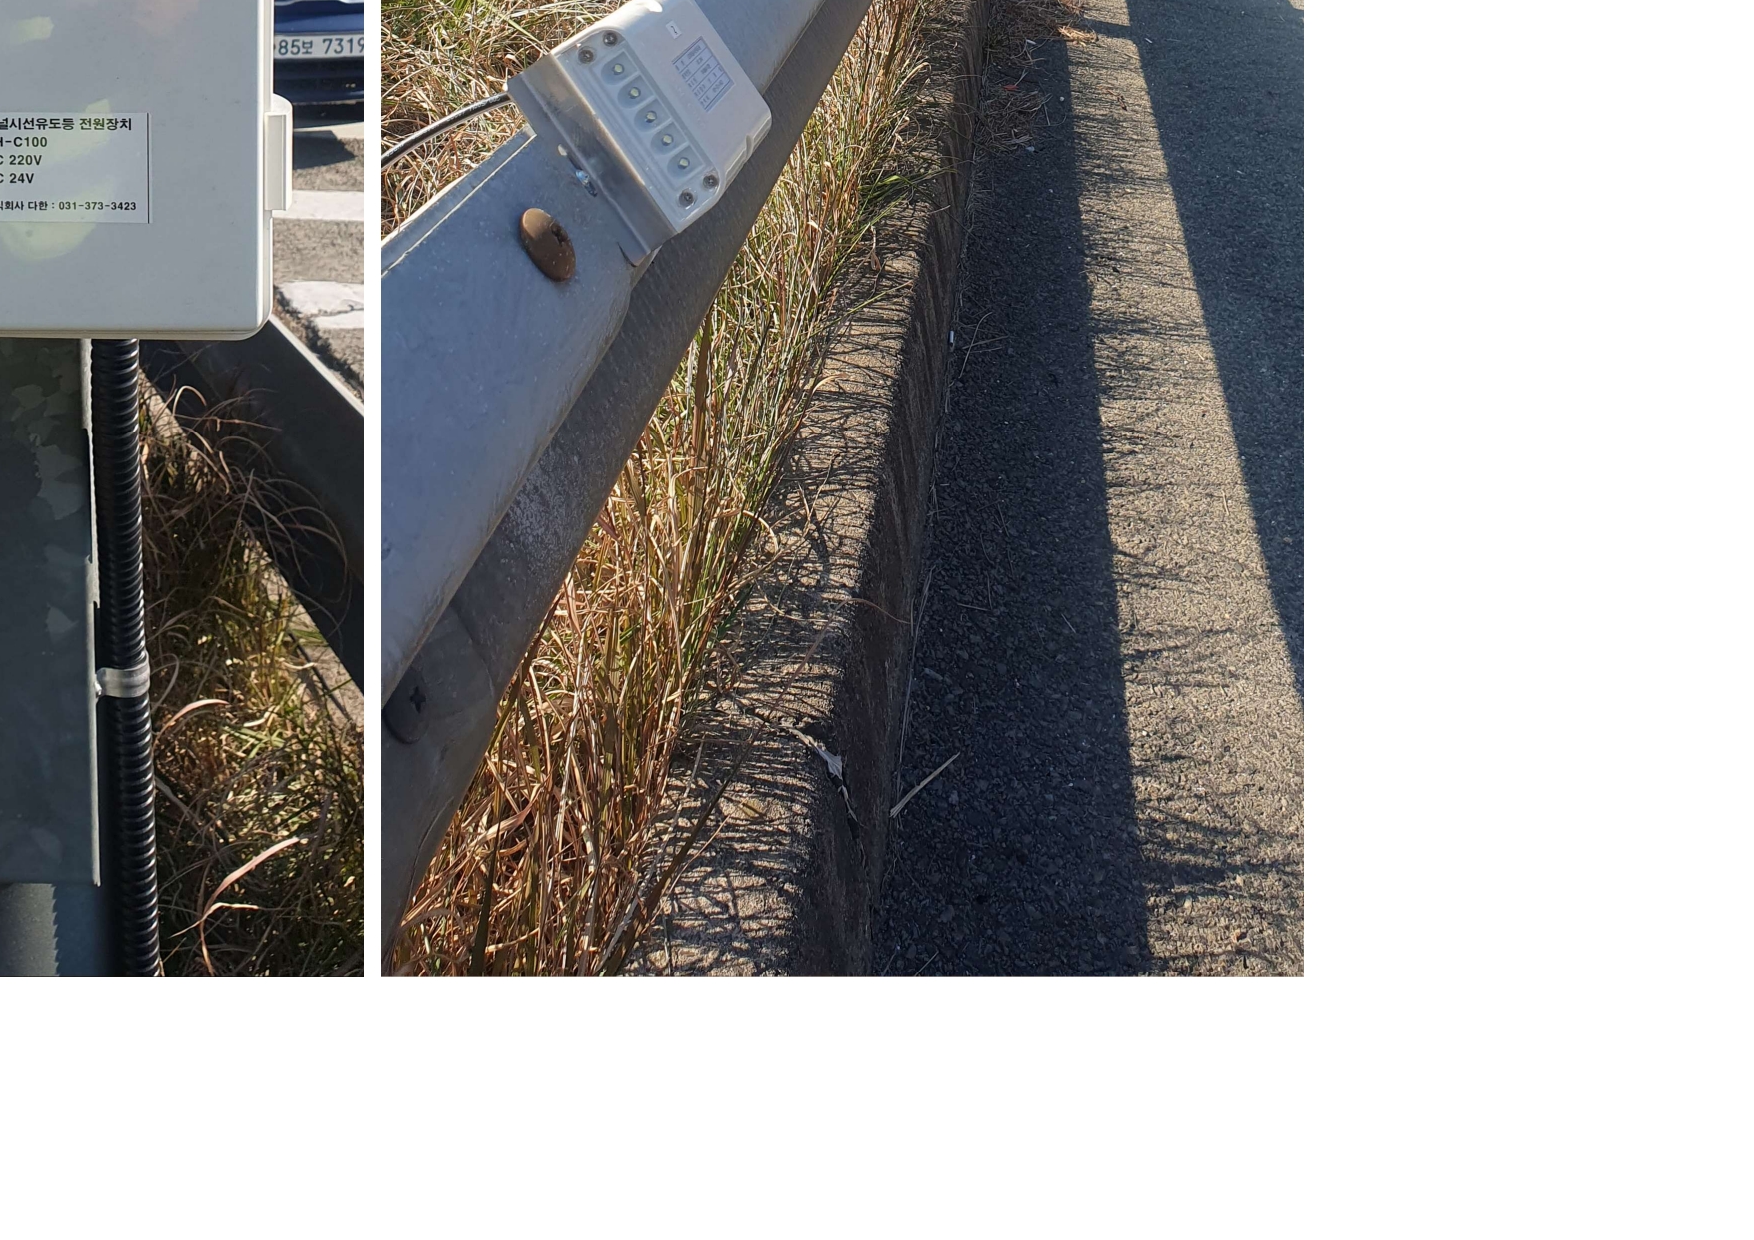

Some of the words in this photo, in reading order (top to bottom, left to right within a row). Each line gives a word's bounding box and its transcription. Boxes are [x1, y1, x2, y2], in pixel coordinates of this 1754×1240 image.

[278, 38, 314, 56] 85보
[322, 36, 364, 54] 7319
[79, 117, 132, 131] 전원장치
[9, 154, 42, 166] 220V
[9, 172, 35, 184] 24V
[27, 200, 48, 210] 다한
[58, 201, 137, 210] 031-373-3423
